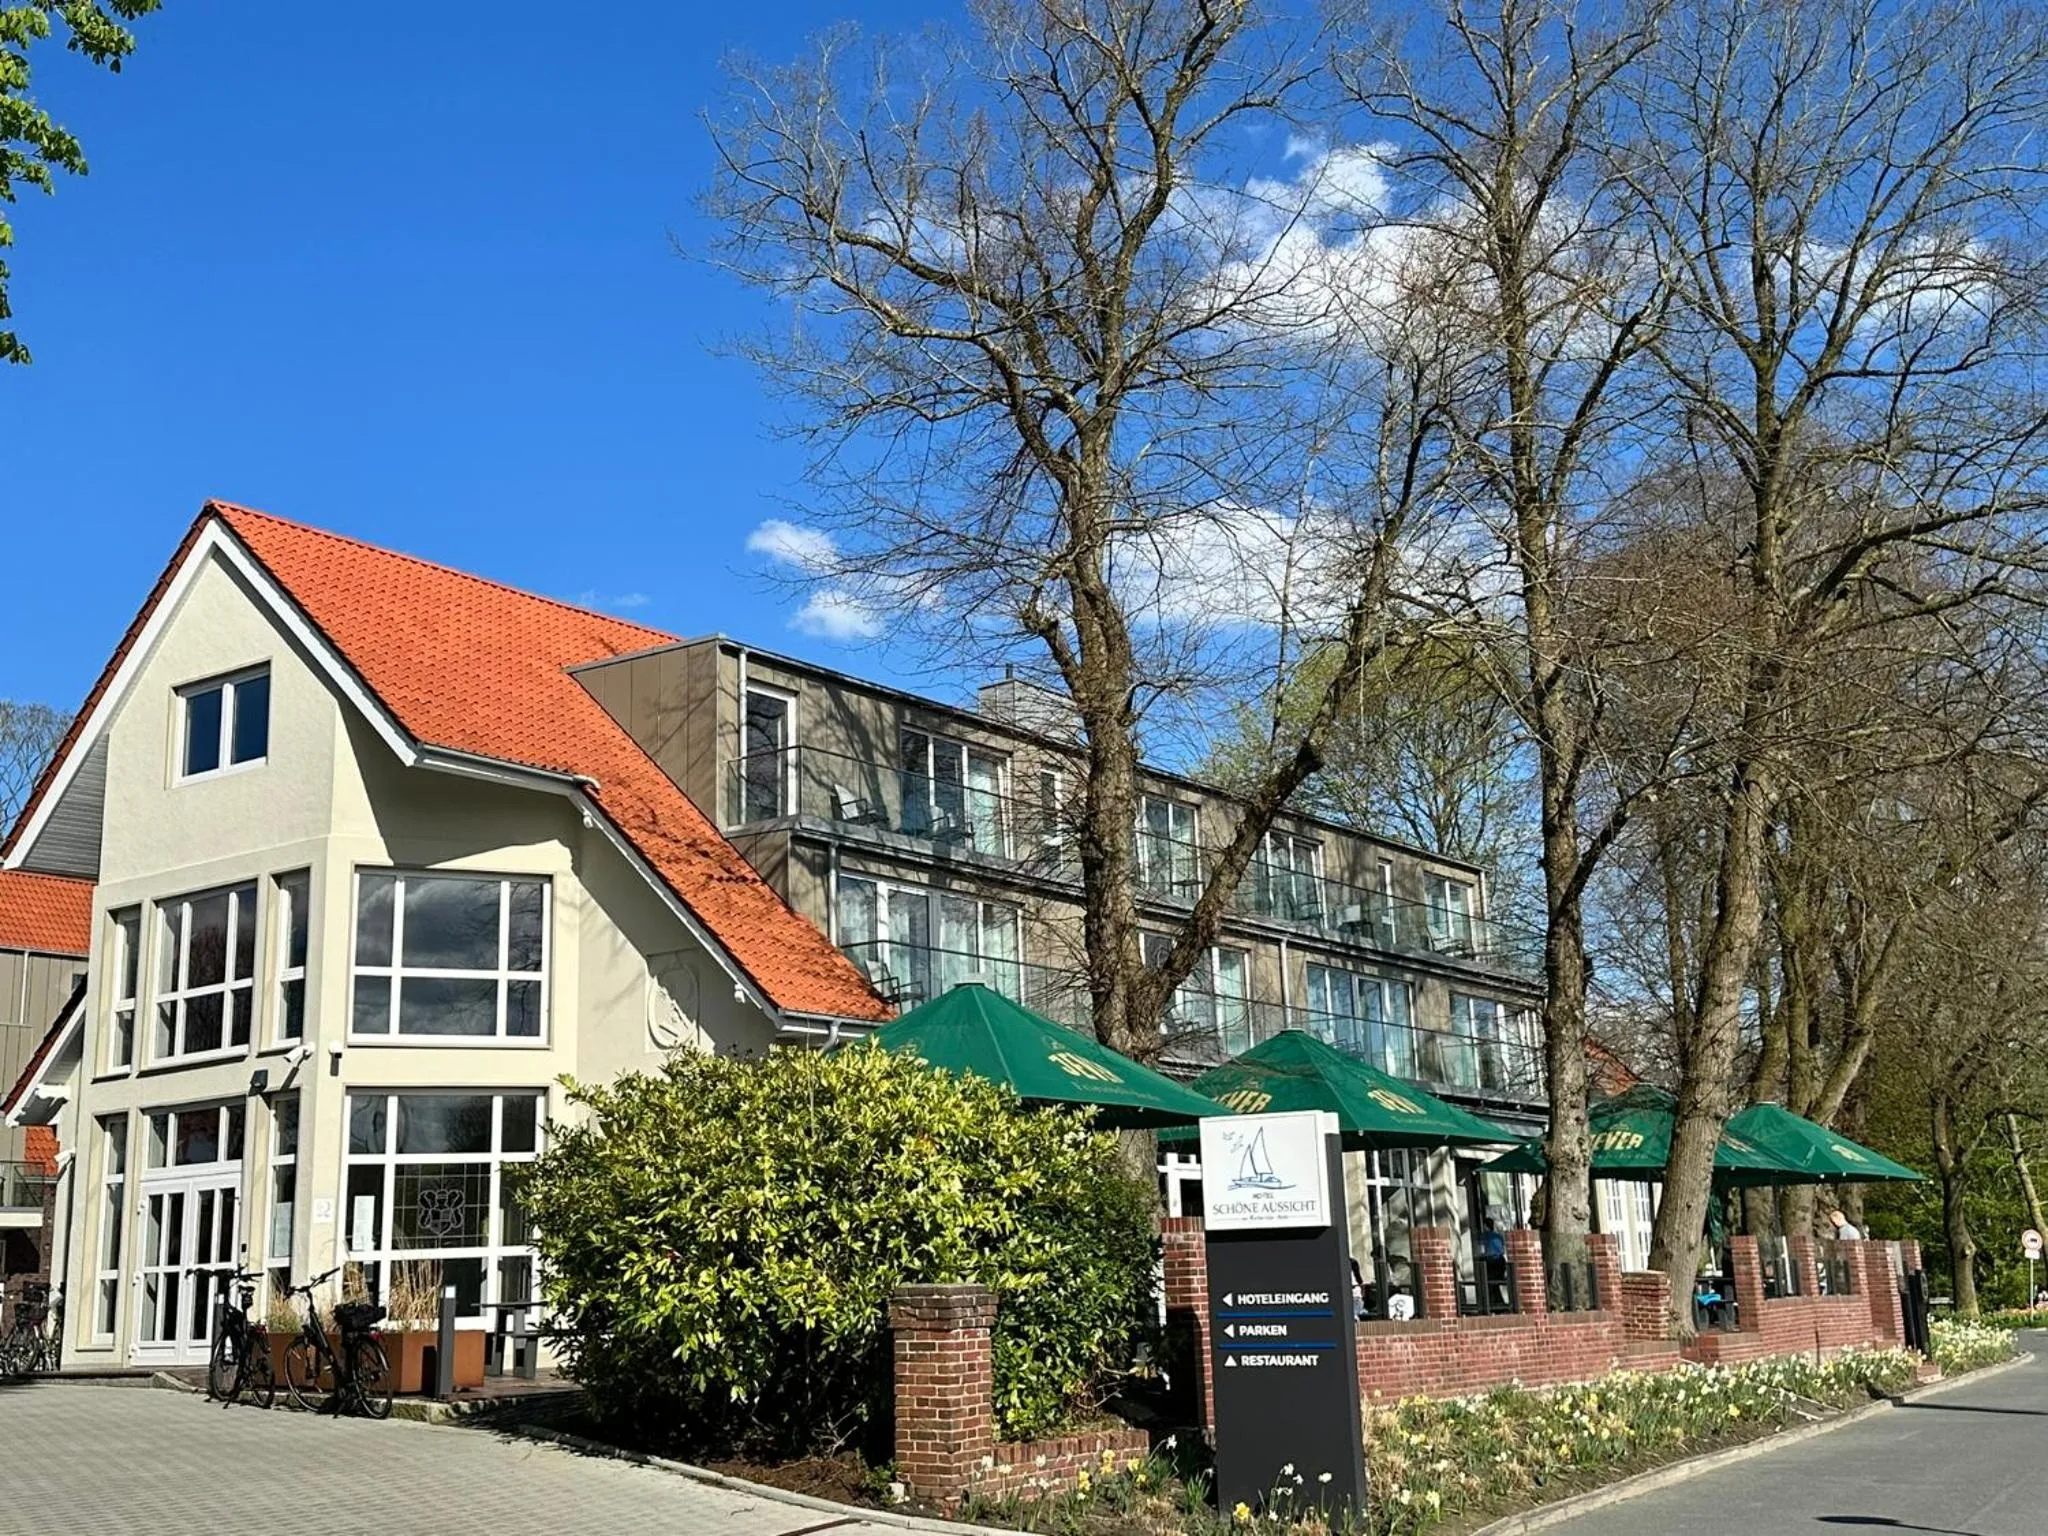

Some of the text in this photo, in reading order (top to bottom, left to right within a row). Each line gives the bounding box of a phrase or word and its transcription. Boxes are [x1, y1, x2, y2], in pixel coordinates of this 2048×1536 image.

[1212, 1199, 1317, 1215] SCHÖNE AUSSICHT
[1237, 1292, 1329, 1305] HOTELEINGANG
[1238, 1324, 1288, 1336] PARKEN
[1240, 1354, 1320, 1367] RESTAURANT
